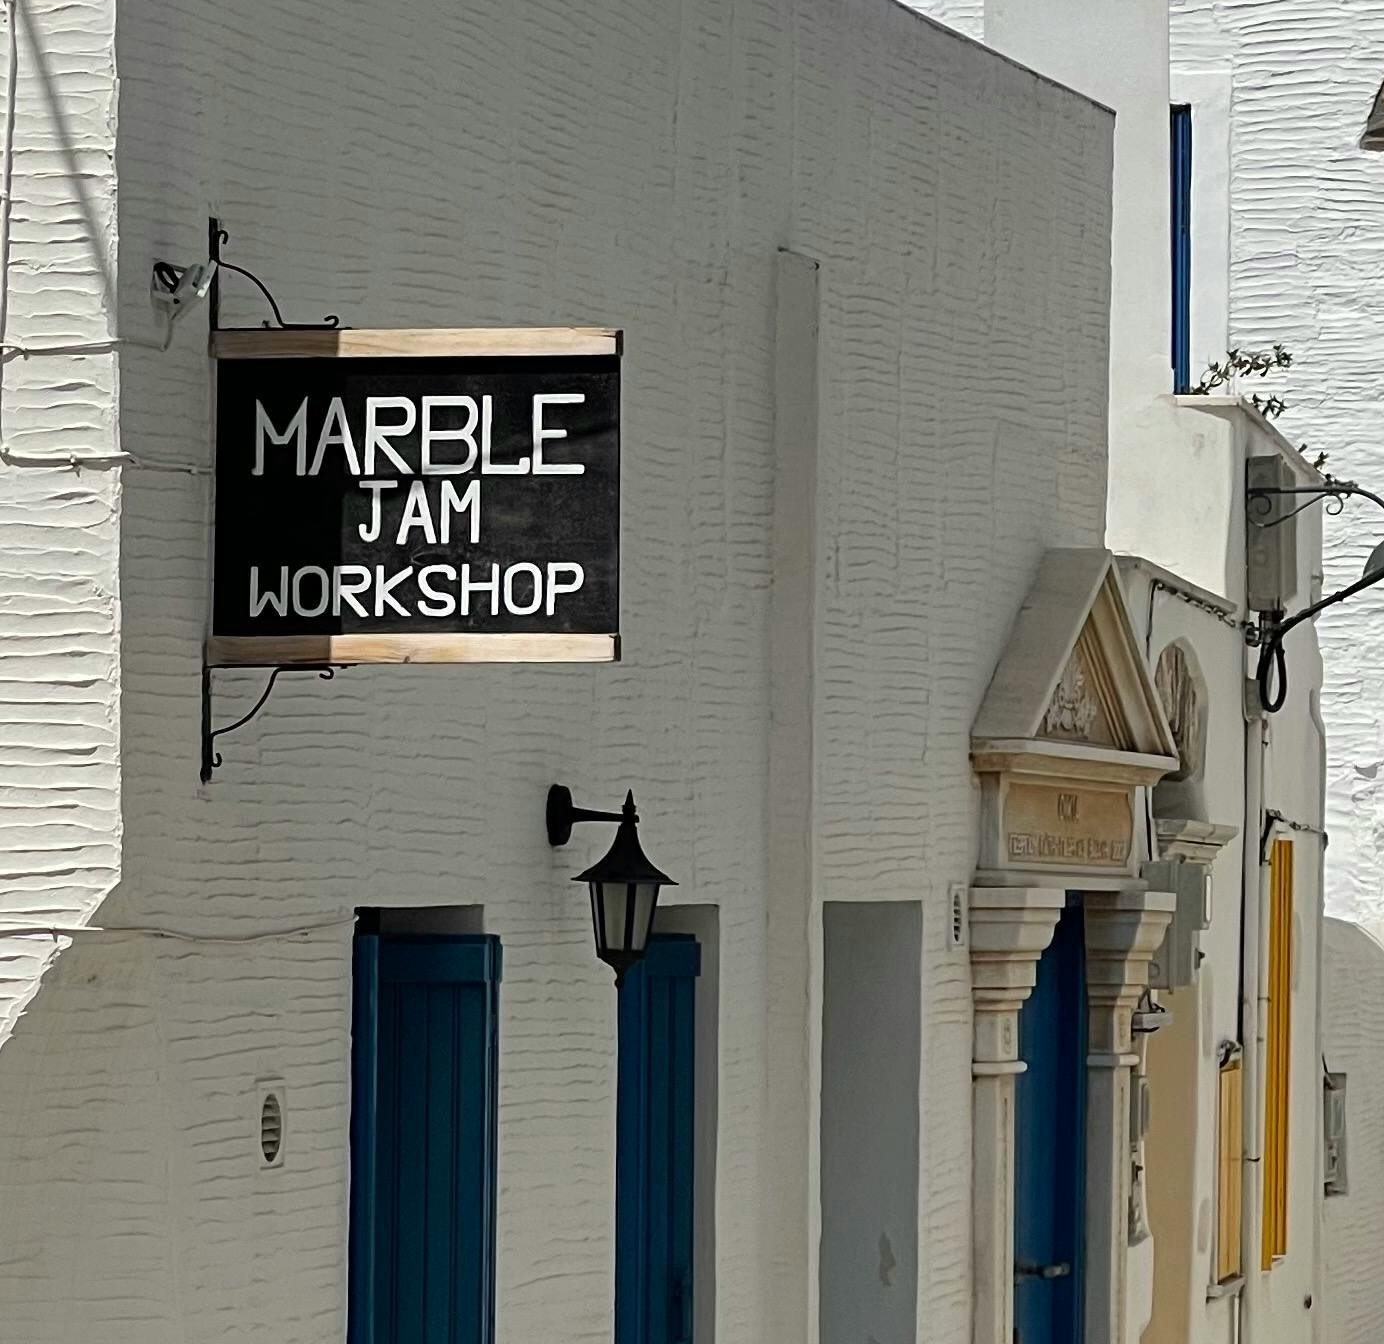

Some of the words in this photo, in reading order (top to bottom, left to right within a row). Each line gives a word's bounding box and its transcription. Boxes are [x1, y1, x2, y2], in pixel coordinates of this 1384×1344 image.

[250, 392, 586, 477] MARBLE
[358, 479, 481, 545] JAM
[248, 561, 585, 618] WORKSHOP
